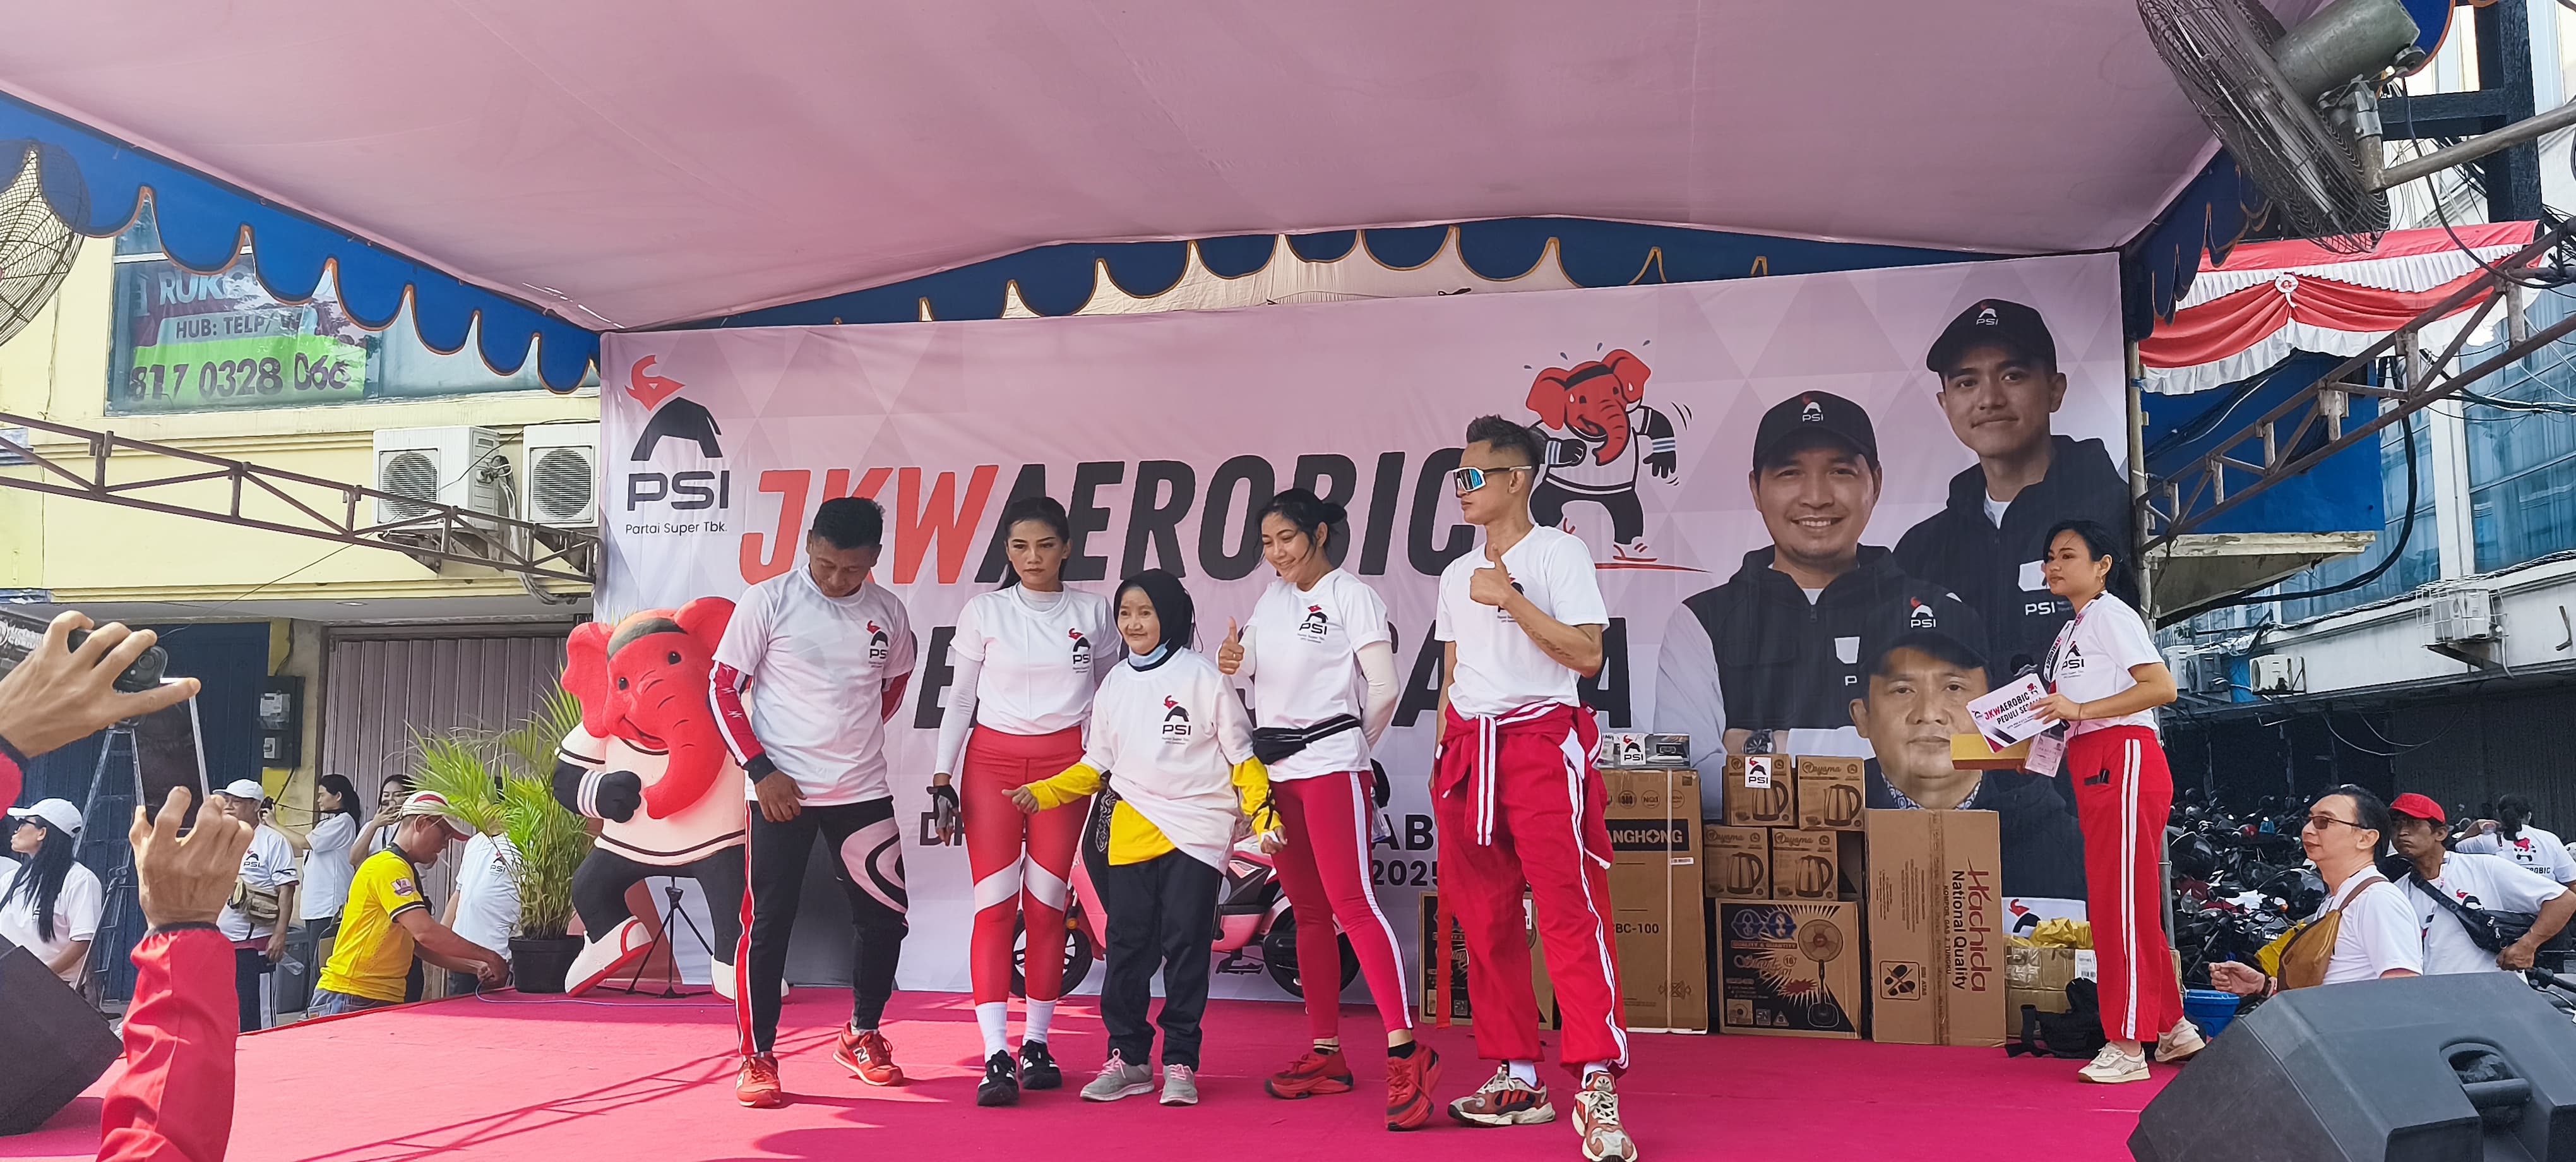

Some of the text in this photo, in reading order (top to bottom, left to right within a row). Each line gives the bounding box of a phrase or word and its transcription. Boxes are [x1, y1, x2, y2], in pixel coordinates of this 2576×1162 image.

[176, 320, 217, 338] HUB:
[199, 357, 283, 398] 0328
[1803, 414, 1823, 422] PSI
[627, 470, 730, 512] PSI
[626, 521, 727, 536] Partai Super Tbk.
[2025, 601, 2055, 616] PSI
[1299, 622, 1327, 635] PSI
[1911, 618, 1936, 628] PSI
[869, 648, 888, 659] PS
[2061, 658, 2085, 671] PSI
[1984, 692, 2030, 721] JKWAEROBIC
[1996, 710, 2019, 725] PEDULI
[1162, 724, 1191, 736] PSI
[1614, 923, 1659, 934] BC-100
[1952, 870, 1968, 990] National Quality
[1967, 856, 1993, 992] Hachida
